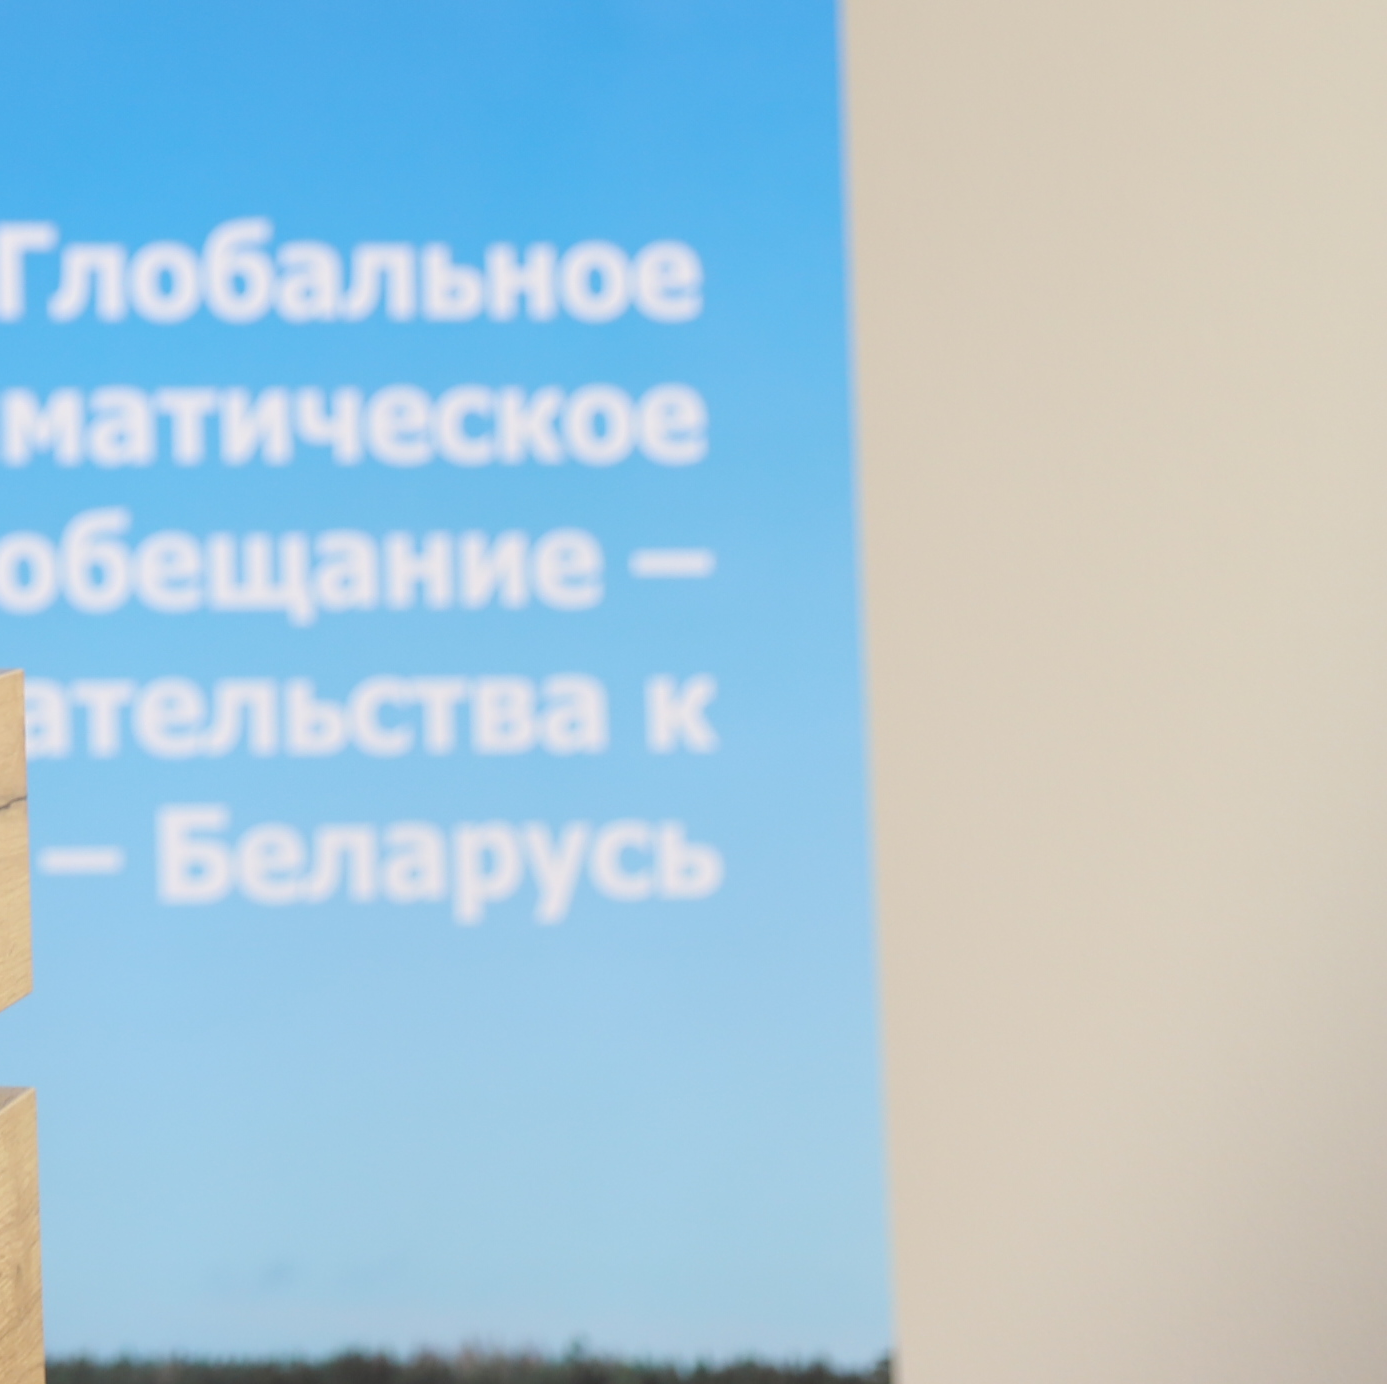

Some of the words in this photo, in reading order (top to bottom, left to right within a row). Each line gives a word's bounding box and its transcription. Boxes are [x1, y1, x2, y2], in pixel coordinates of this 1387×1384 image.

[24, 672, 609, 757] ательства
[646, 674, 718, 754] к
[157, 803, 724, 925] Беларусь
